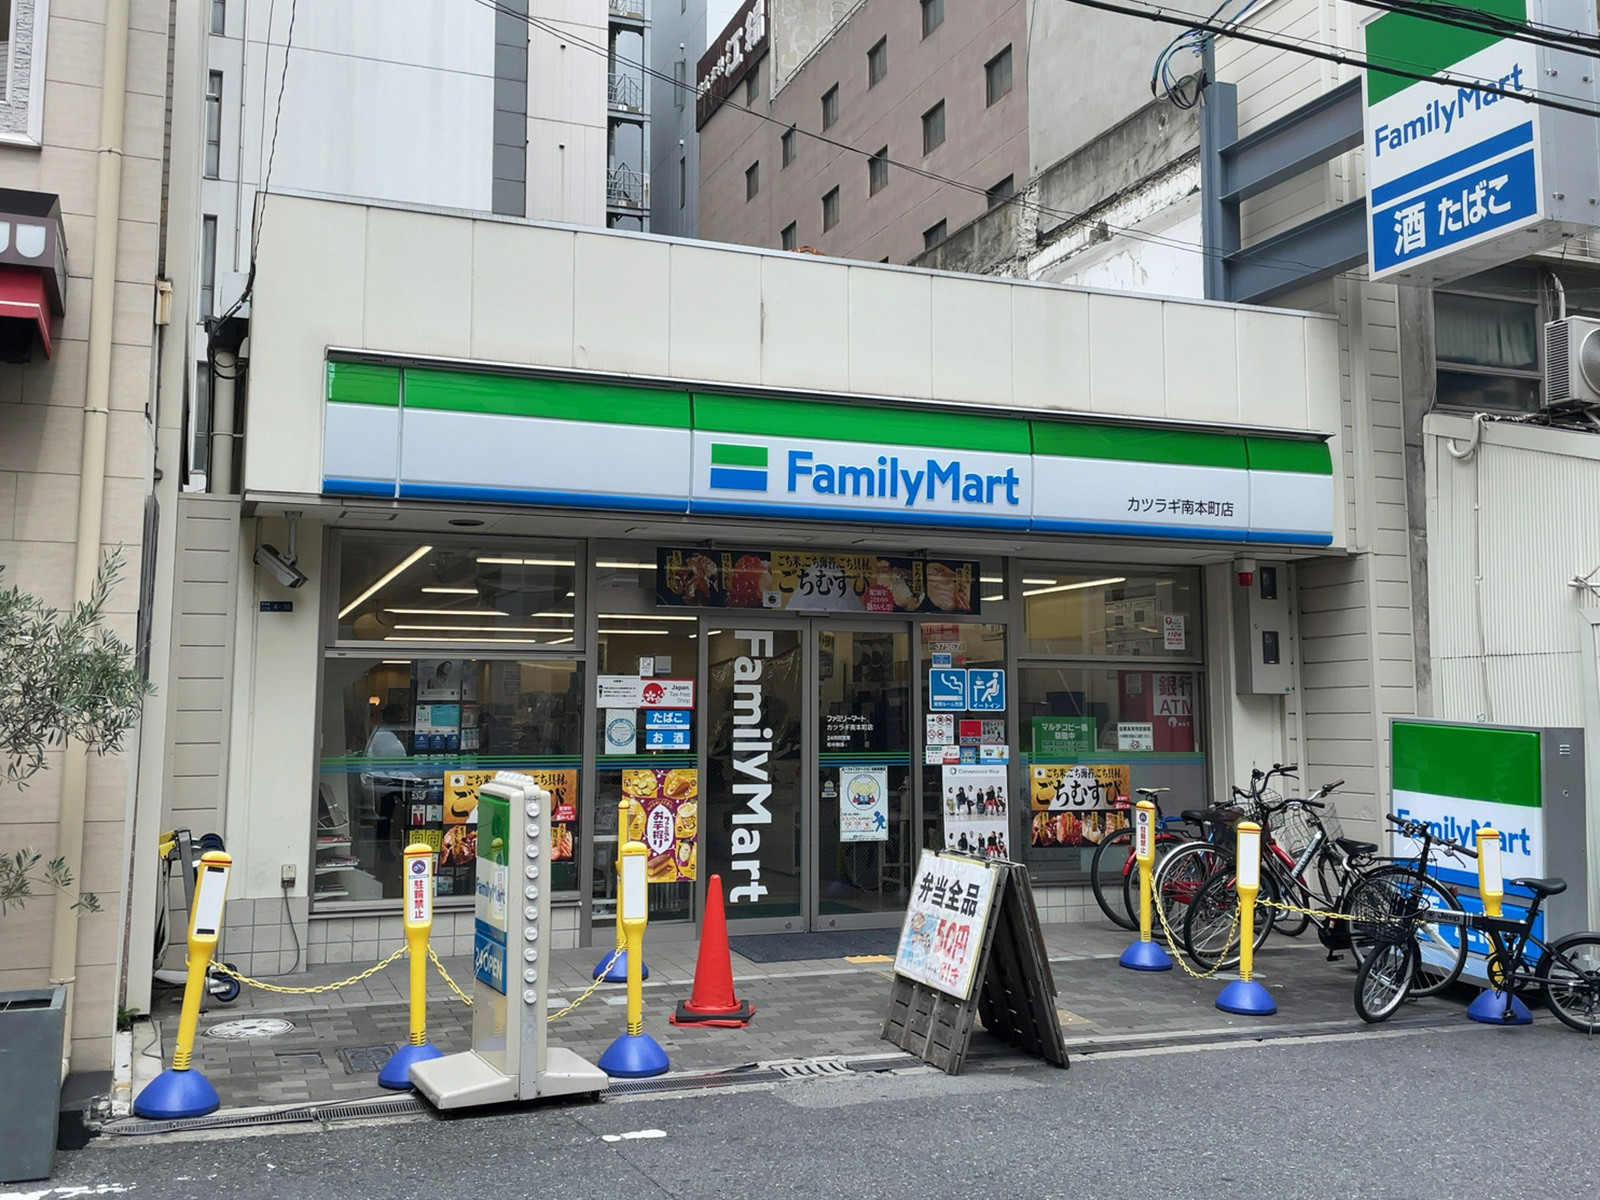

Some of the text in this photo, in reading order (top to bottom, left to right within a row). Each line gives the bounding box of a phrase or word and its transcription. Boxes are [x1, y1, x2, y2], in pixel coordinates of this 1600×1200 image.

[1375, 62, 1523, 157] FamilyMart
[1393, 174, 1512, 256] 酒 たばこ
[787, 450, 1020, 506] FamilyMart
[1127, 497, 1235, 517] カツラギ南本町店
[778, 569, 871, 598] ごちむすび
[652, 713, 683, 723] たばこ
[1159, 699, 1193, 715] ATM
[652, 732, 684, 743] お酒
[730, 629, 774, 903] FamilyMart
[1036, 779, 1123, 808] ごちむすび
[413, 880, 424, 919] 駐輪禁止
[917, 871, 980, 918] 弁当全品
[1437, 911, 1461, 922] Jeep
